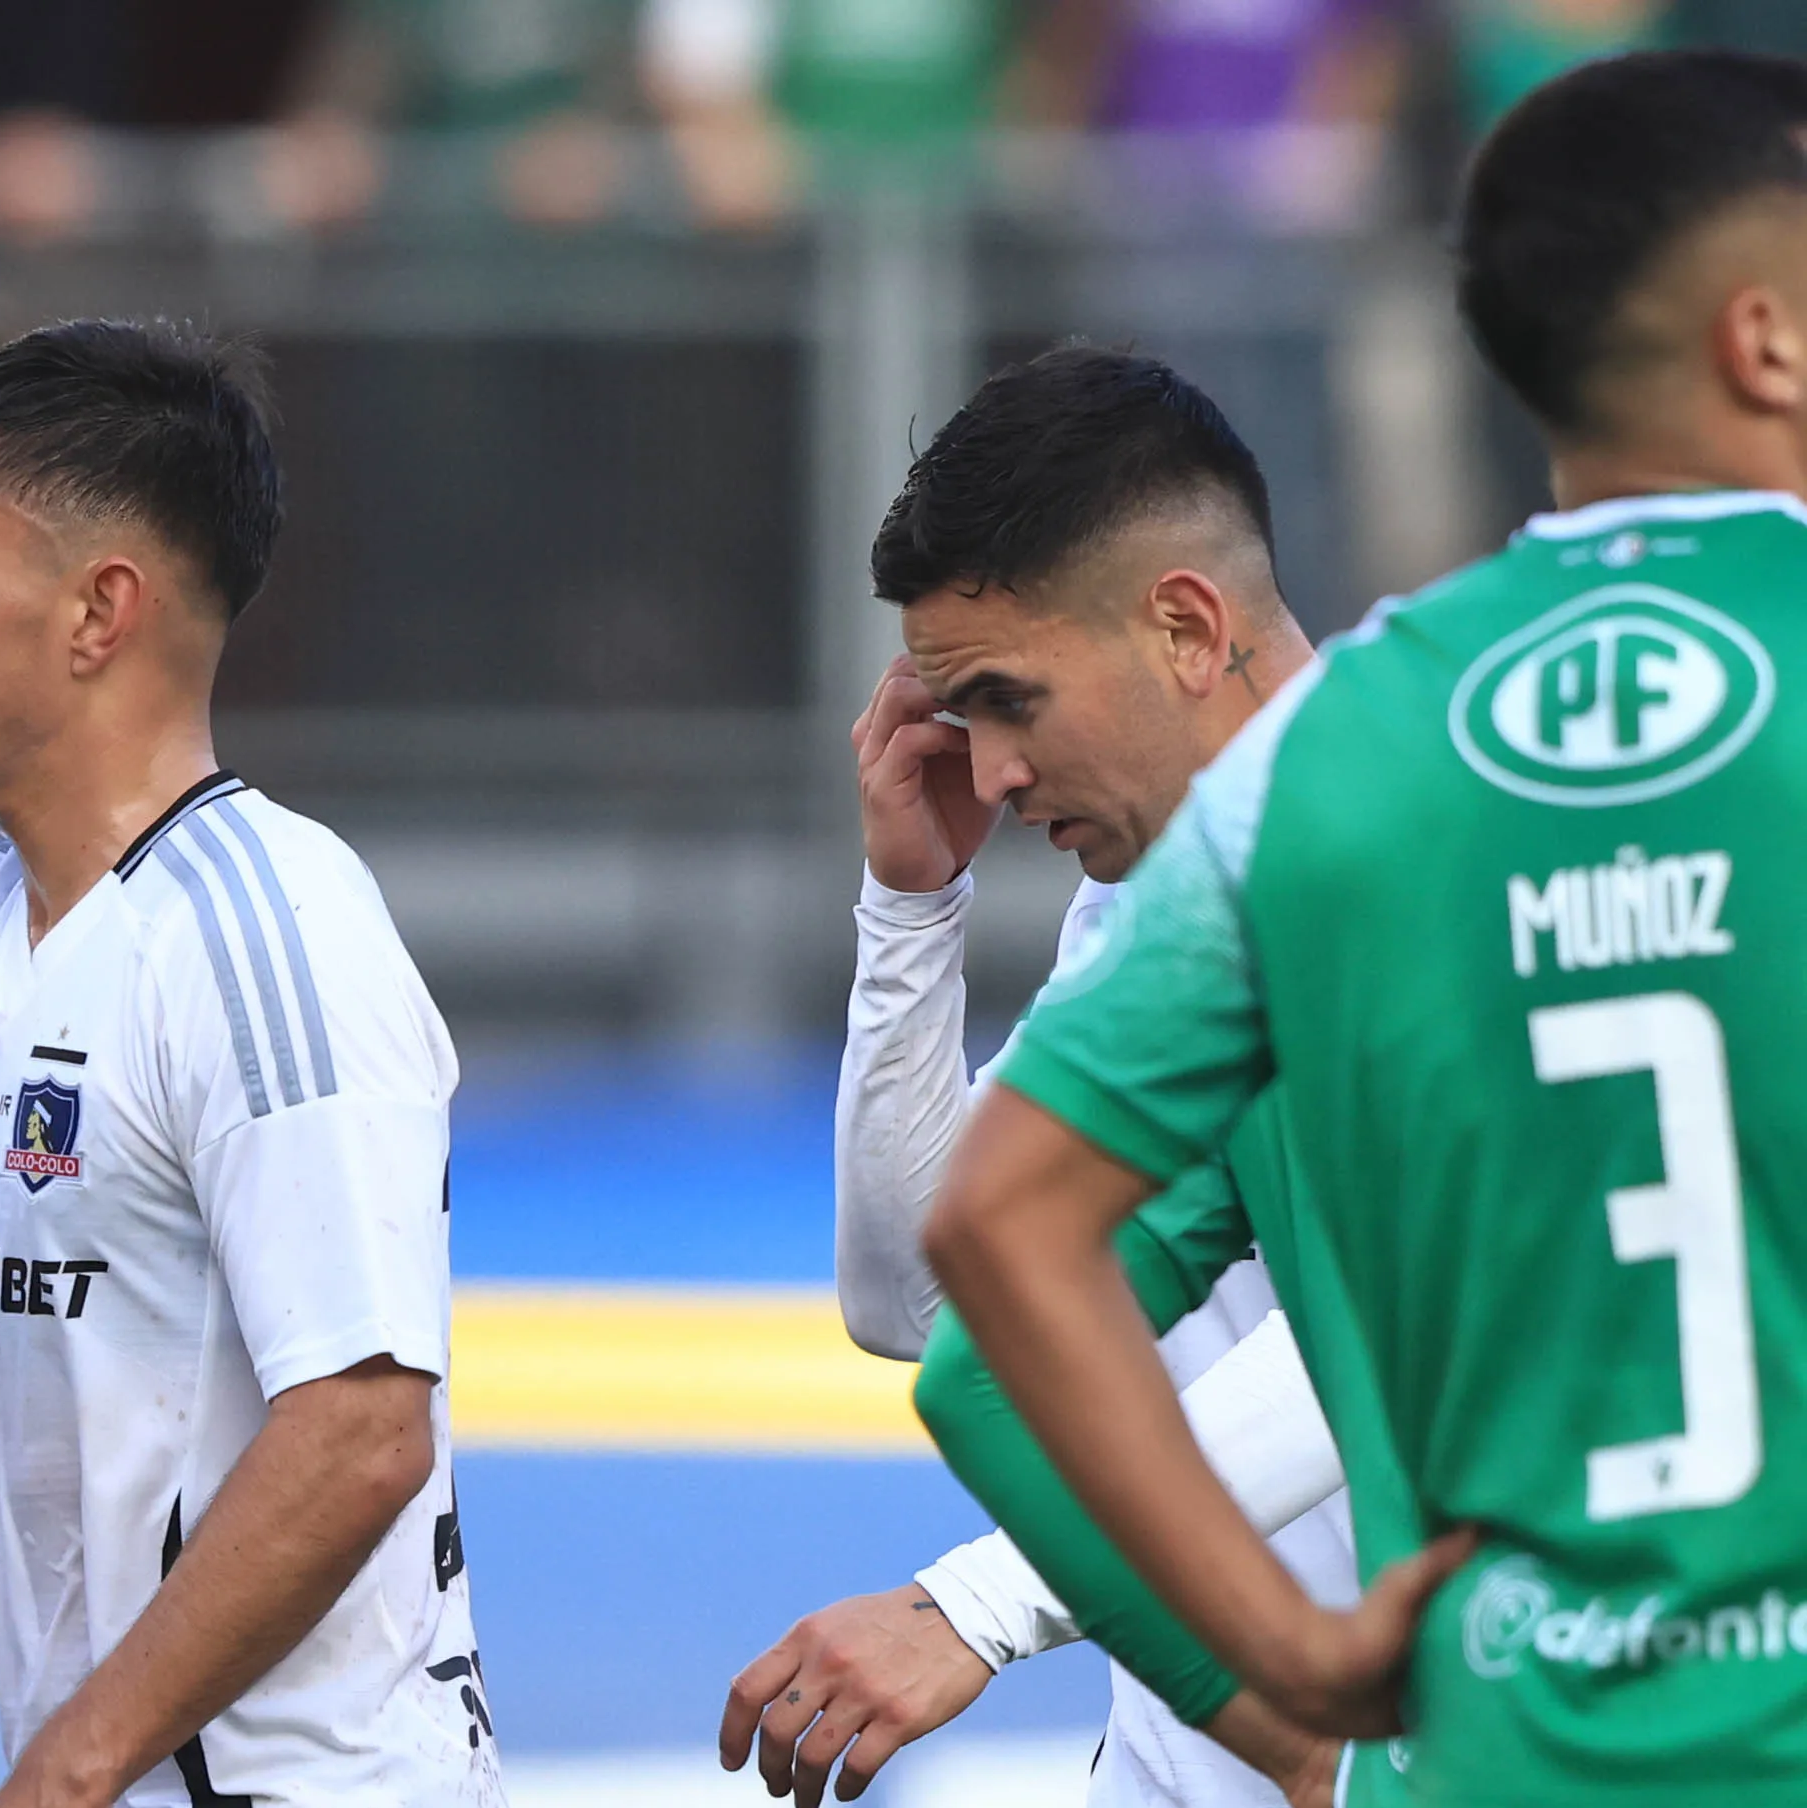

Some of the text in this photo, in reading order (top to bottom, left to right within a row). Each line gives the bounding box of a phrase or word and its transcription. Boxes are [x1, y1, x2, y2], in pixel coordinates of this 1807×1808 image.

[1506, 845, 1736, 979] MUÑOZ
[7, 1152, 76, 1174] COLO-COLO
[1526, 990, 1763, 1523] 3
